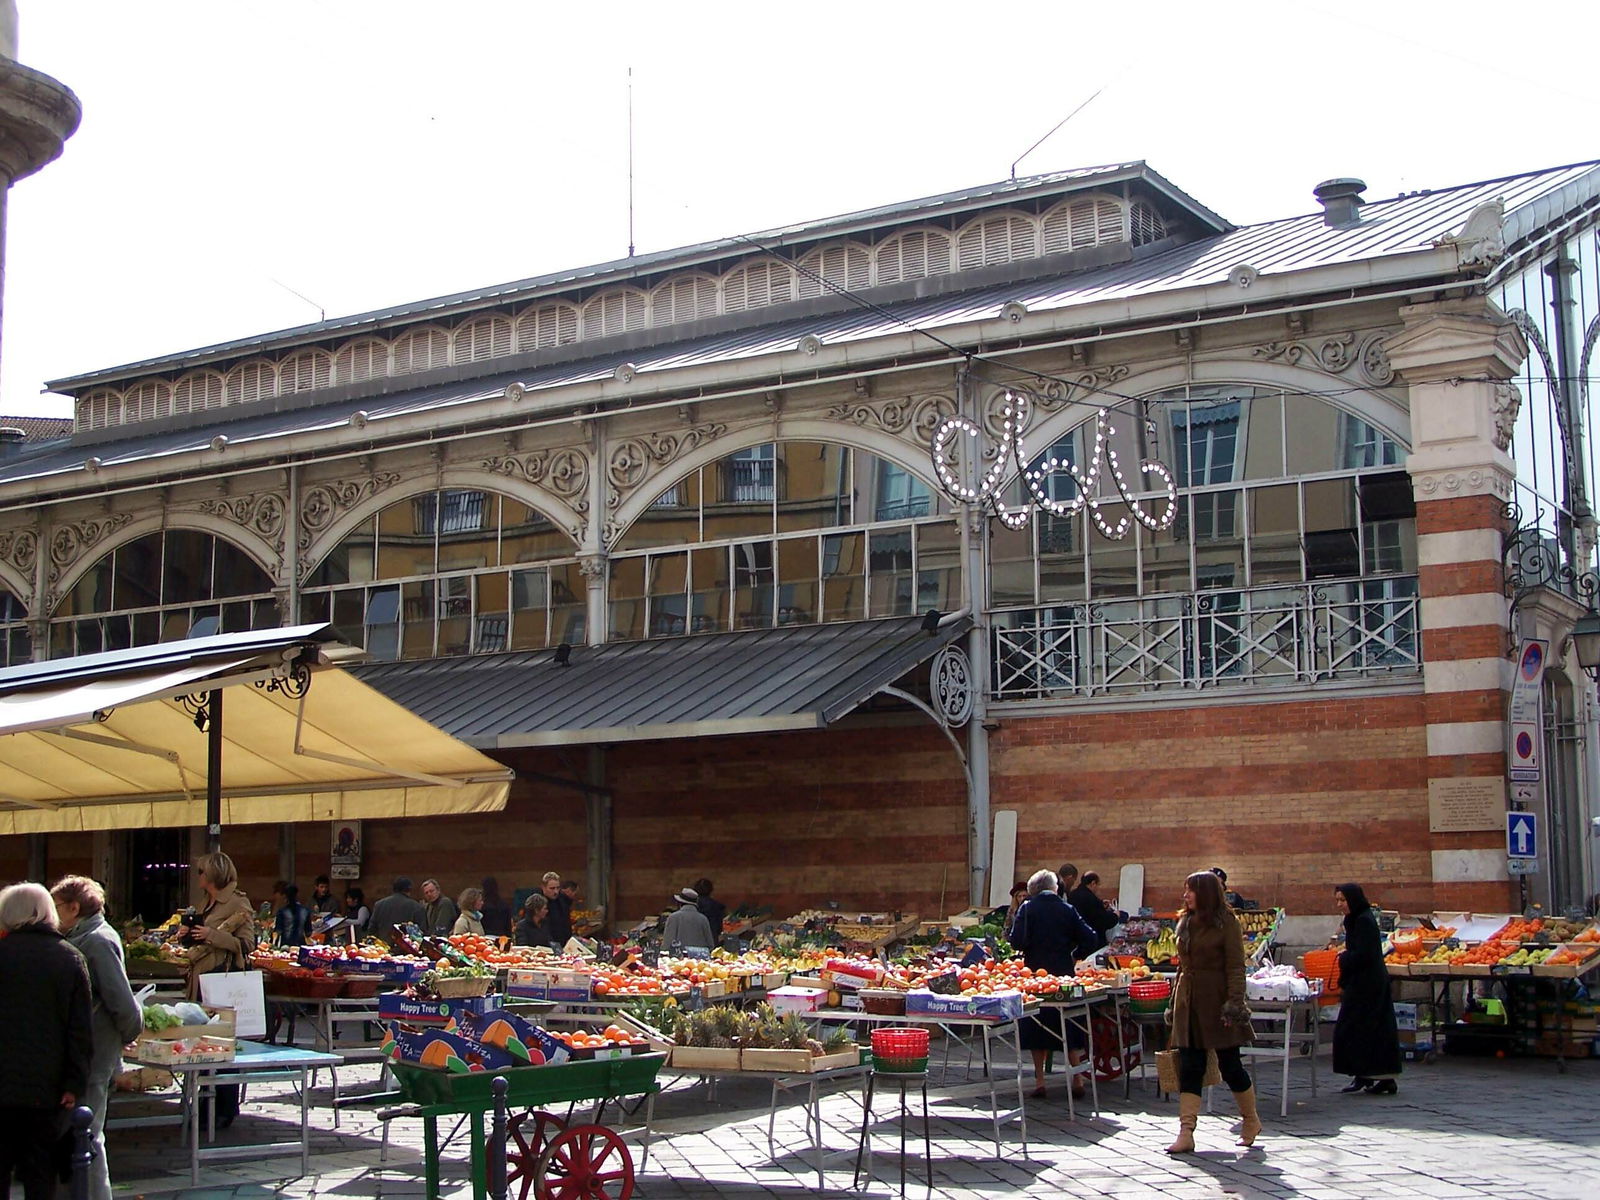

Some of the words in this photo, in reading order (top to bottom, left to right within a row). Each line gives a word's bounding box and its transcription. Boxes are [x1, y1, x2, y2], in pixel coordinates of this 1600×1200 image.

[400, 1002, 420, 1015] Happy
[421, 1003, 437, 1014] Tree
[927, 1001, 948, 1012] Happy
[949, 1002, 964, 1012] Tree
